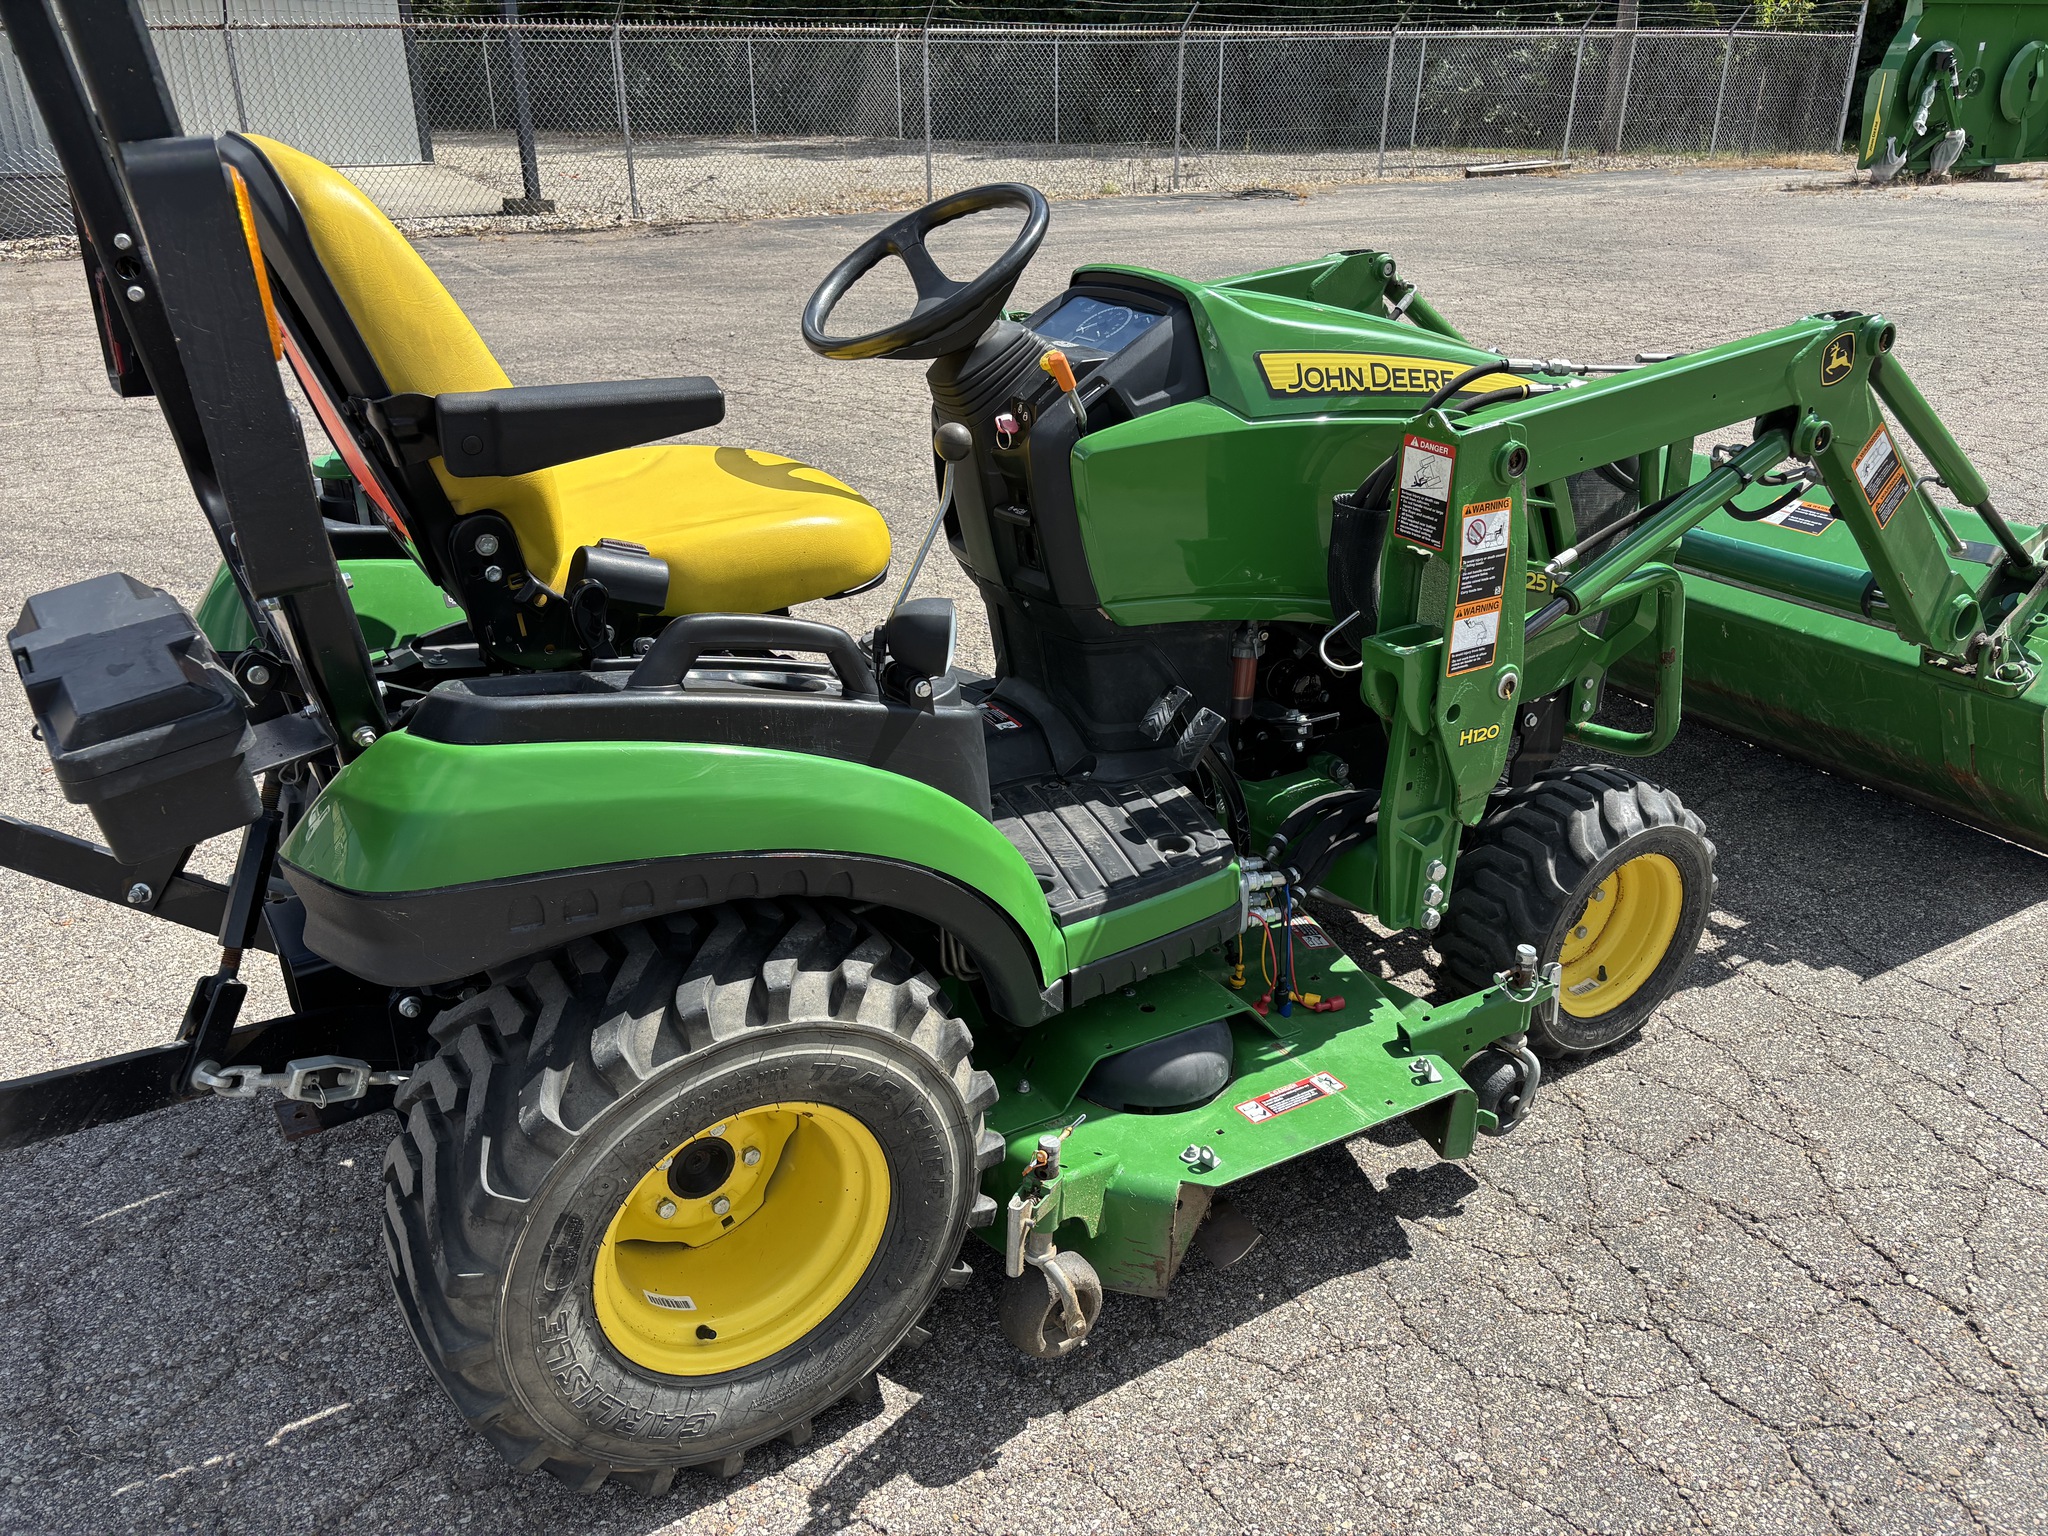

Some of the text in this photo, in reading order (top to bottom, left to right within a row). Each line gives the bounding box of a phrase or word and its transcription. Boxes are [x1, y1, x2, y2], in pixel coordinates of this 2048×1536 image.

[1288, 362, 1454, 389] JOHN DEERE
[1420, 440, 1449, 455] DANGER
[1860, 430, 1881, 458] WARNING
[1881, 473, 1901, 501] WARNING
[1472, 500, 1510, 514] WARNING
[1463, 601, 1500, 616] WARNING
[1459, 724, 1501, 747] H120
[809, 1061, 946, 1199] TRAC CHIEF
[538, 1309, 719, 1439] CARLISLE
